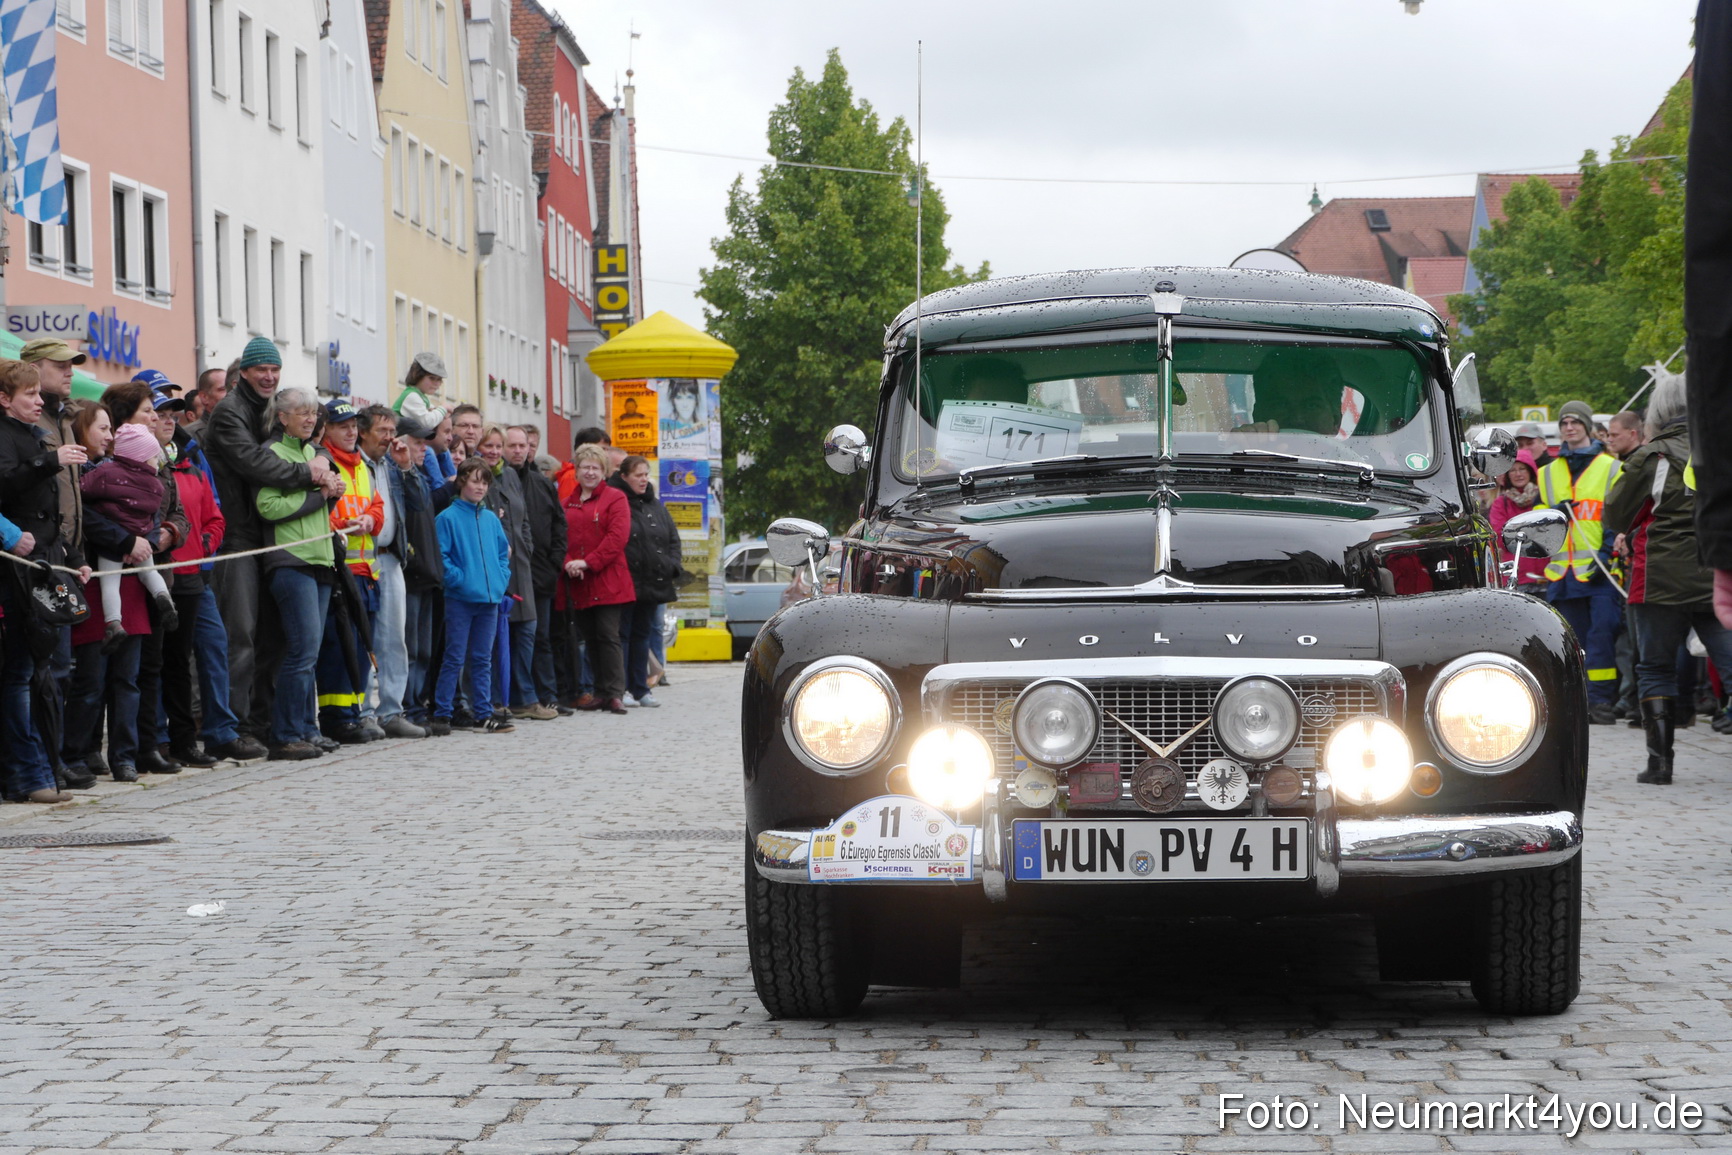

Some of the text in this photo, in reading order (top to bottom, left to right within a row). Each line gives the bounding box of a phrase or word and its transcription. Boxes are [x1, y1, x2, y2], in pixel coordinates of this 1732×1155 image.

[618, 431, 649, 440] 01.06.
[1002, 427, 1046, 454] 171
[668, 469, 697, 486] G6
[1009, 633, 1318, 649] VOLVO
[879, 806, 901, 838] 11
[878, 845, 911, 862] Egrensis
[912, 839, 941, 859] Classic
[1044, 828, 1125, 872] WUN
[1160, 827, 1213, 872] PV
[1230, 827, 1253, 871] 4
[1273, 827, 1297, 871] H
[1023, 857, 1033, 869] D
